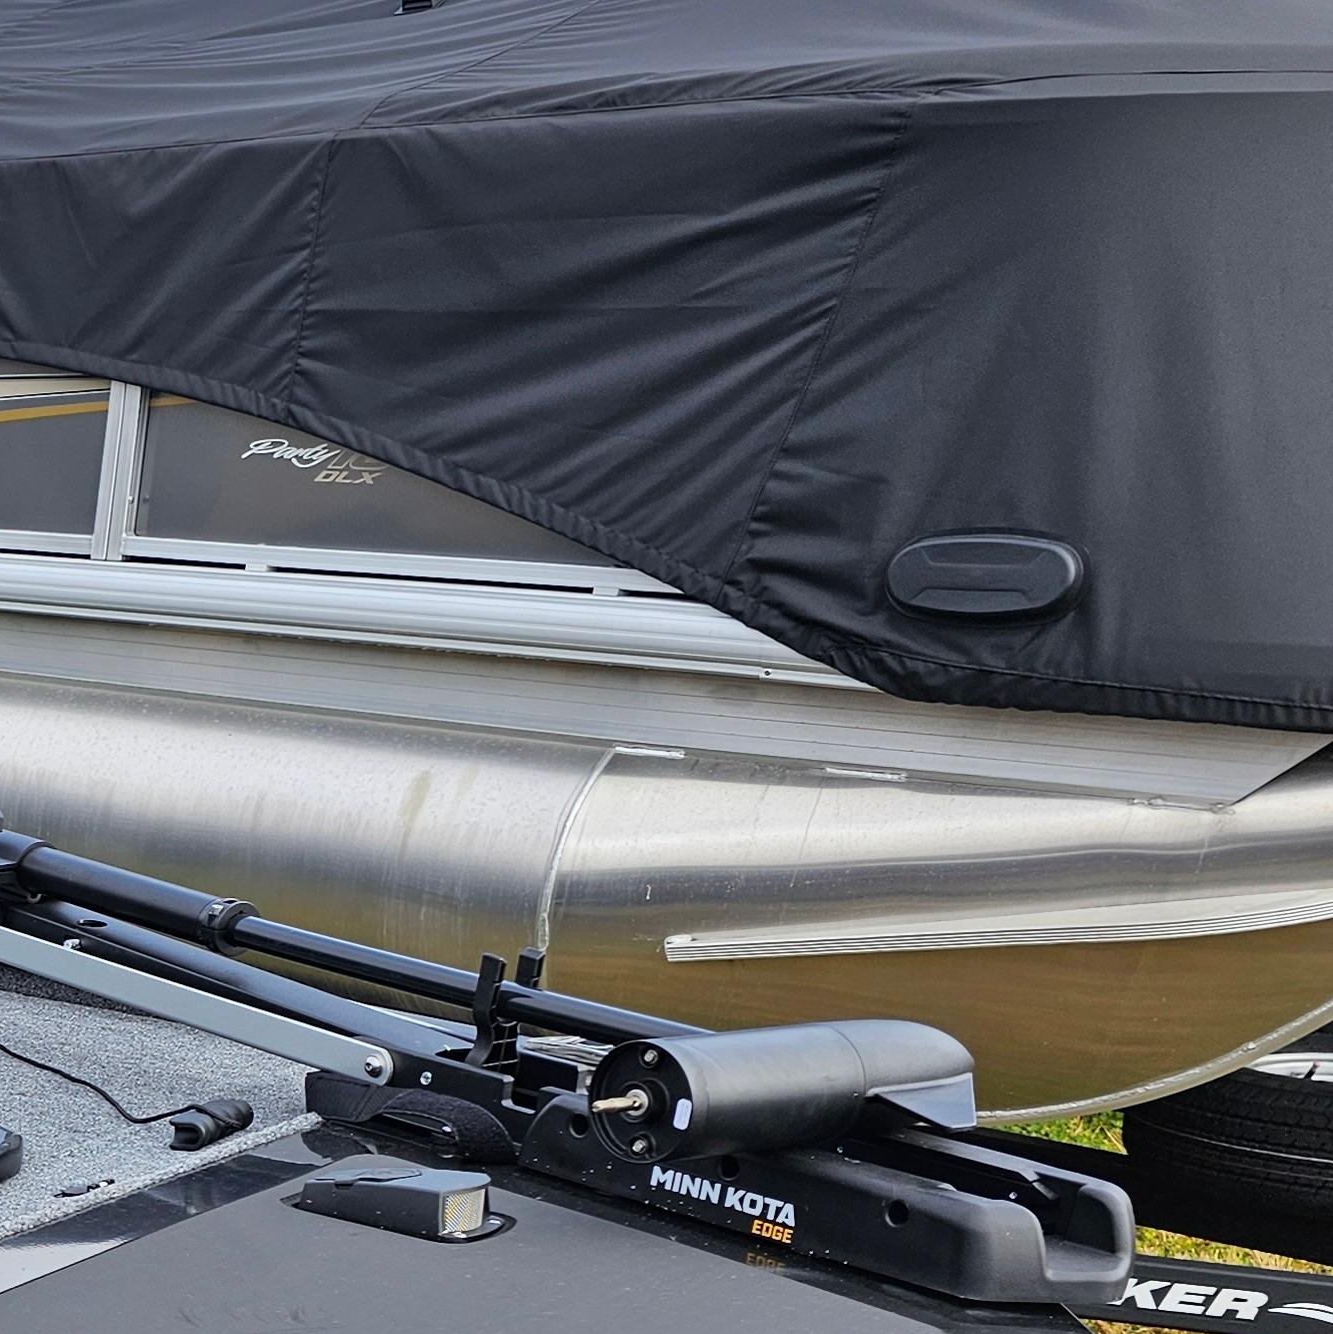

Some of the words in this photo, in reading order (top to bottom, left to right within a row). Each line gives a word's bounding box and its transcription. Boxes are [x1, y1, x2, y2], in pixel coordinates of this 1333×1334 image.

[241, 438, 340, 468] Party
[314, 470, 382, 484] DLX
[650, 1165, 721, 1205] MINN
[724, 1186, 796, 1227] KOTA
[751, 1219, 794, 1244] EDGE
[1107, 1277, 1269, 1321] KER
